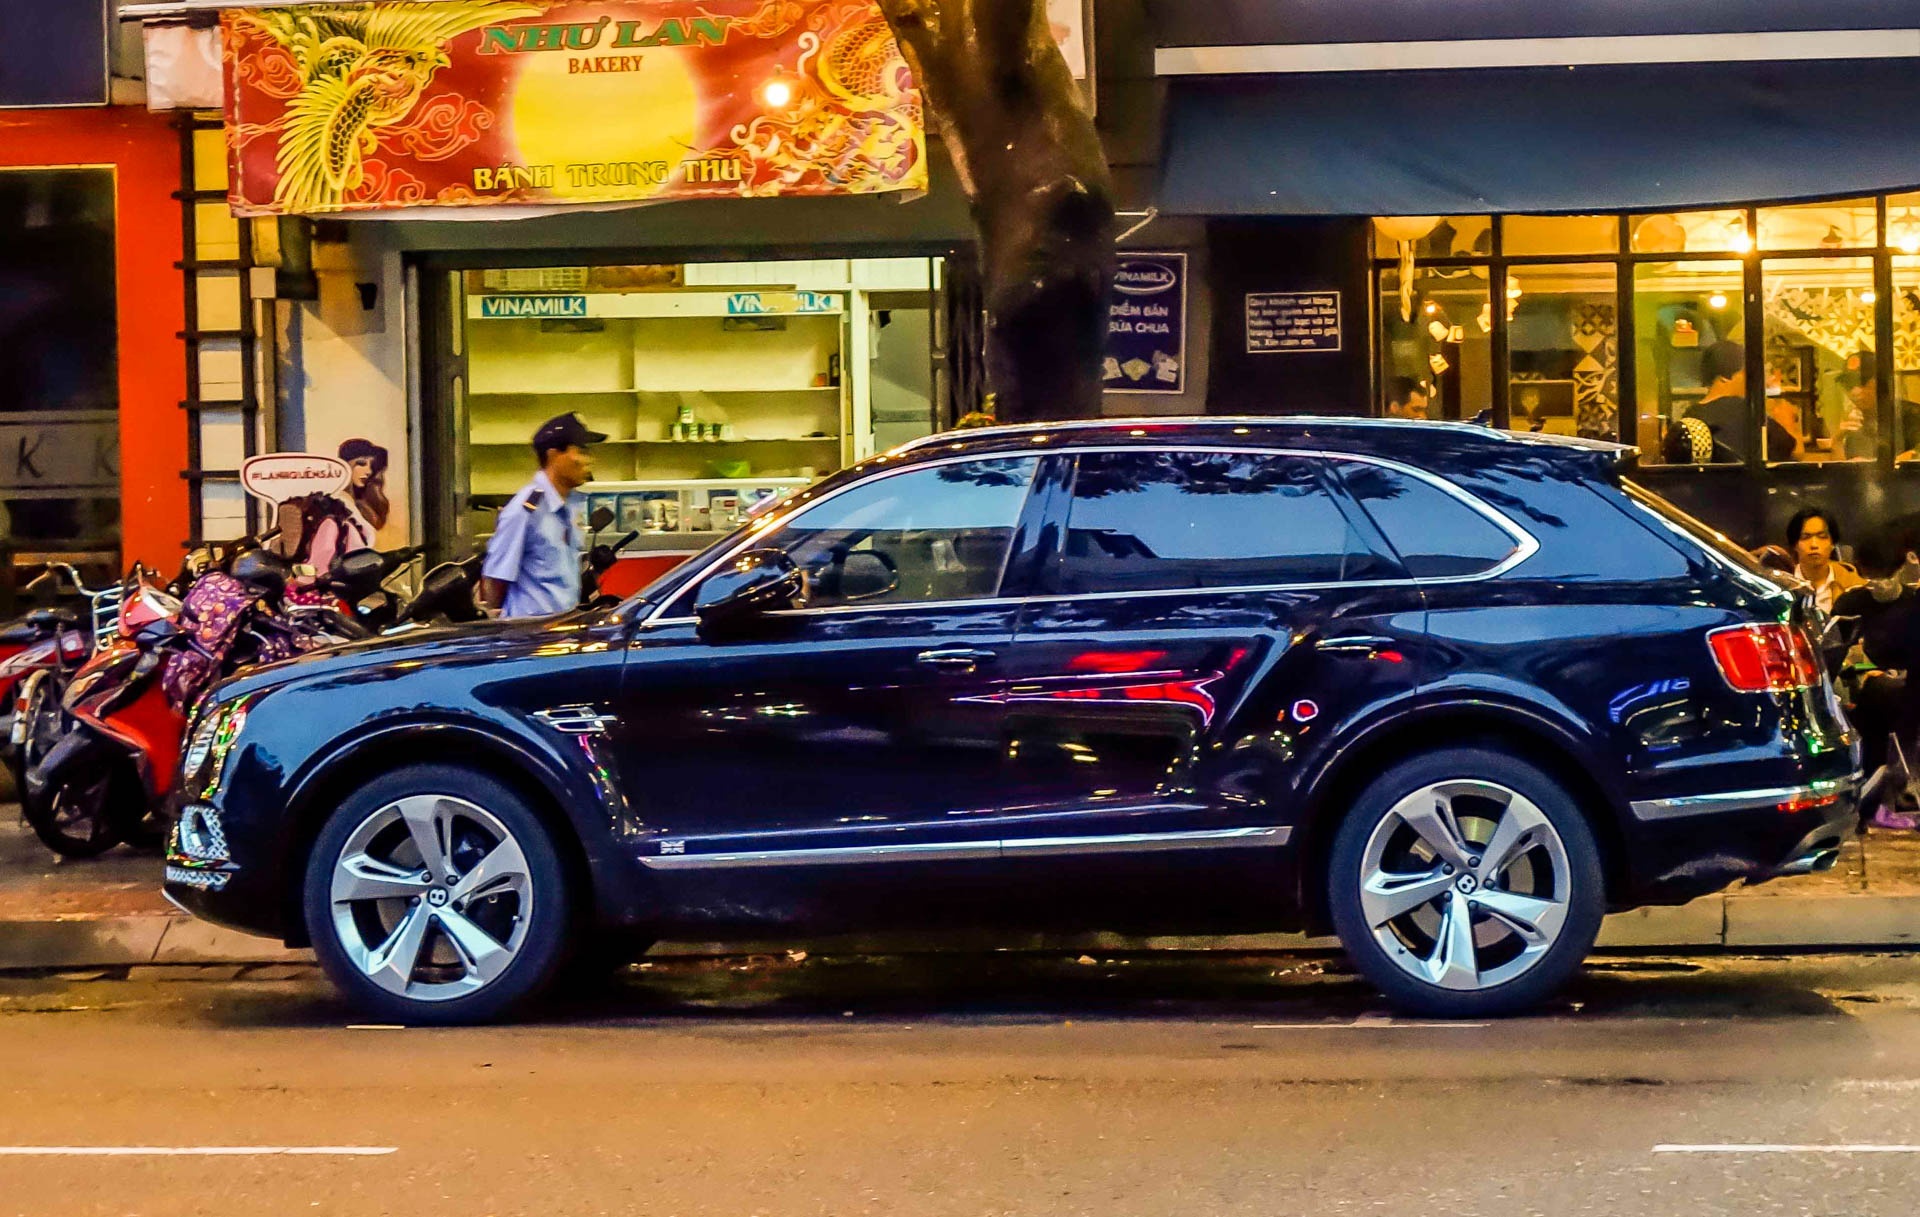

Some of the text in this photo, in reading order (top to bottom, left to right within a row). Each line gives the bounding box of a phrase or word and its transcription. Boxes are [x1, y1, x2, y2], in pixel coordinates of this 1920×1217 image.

[478, 16, 731, 54] NHƯ LAN
[568, 55, 645, 75] BAKERY
[473, 158, 743, 191] BÁNH TRUNG THU
[486, 297, 584, 315] VINAMILK
[730, 293, 832, 313] VINILK
